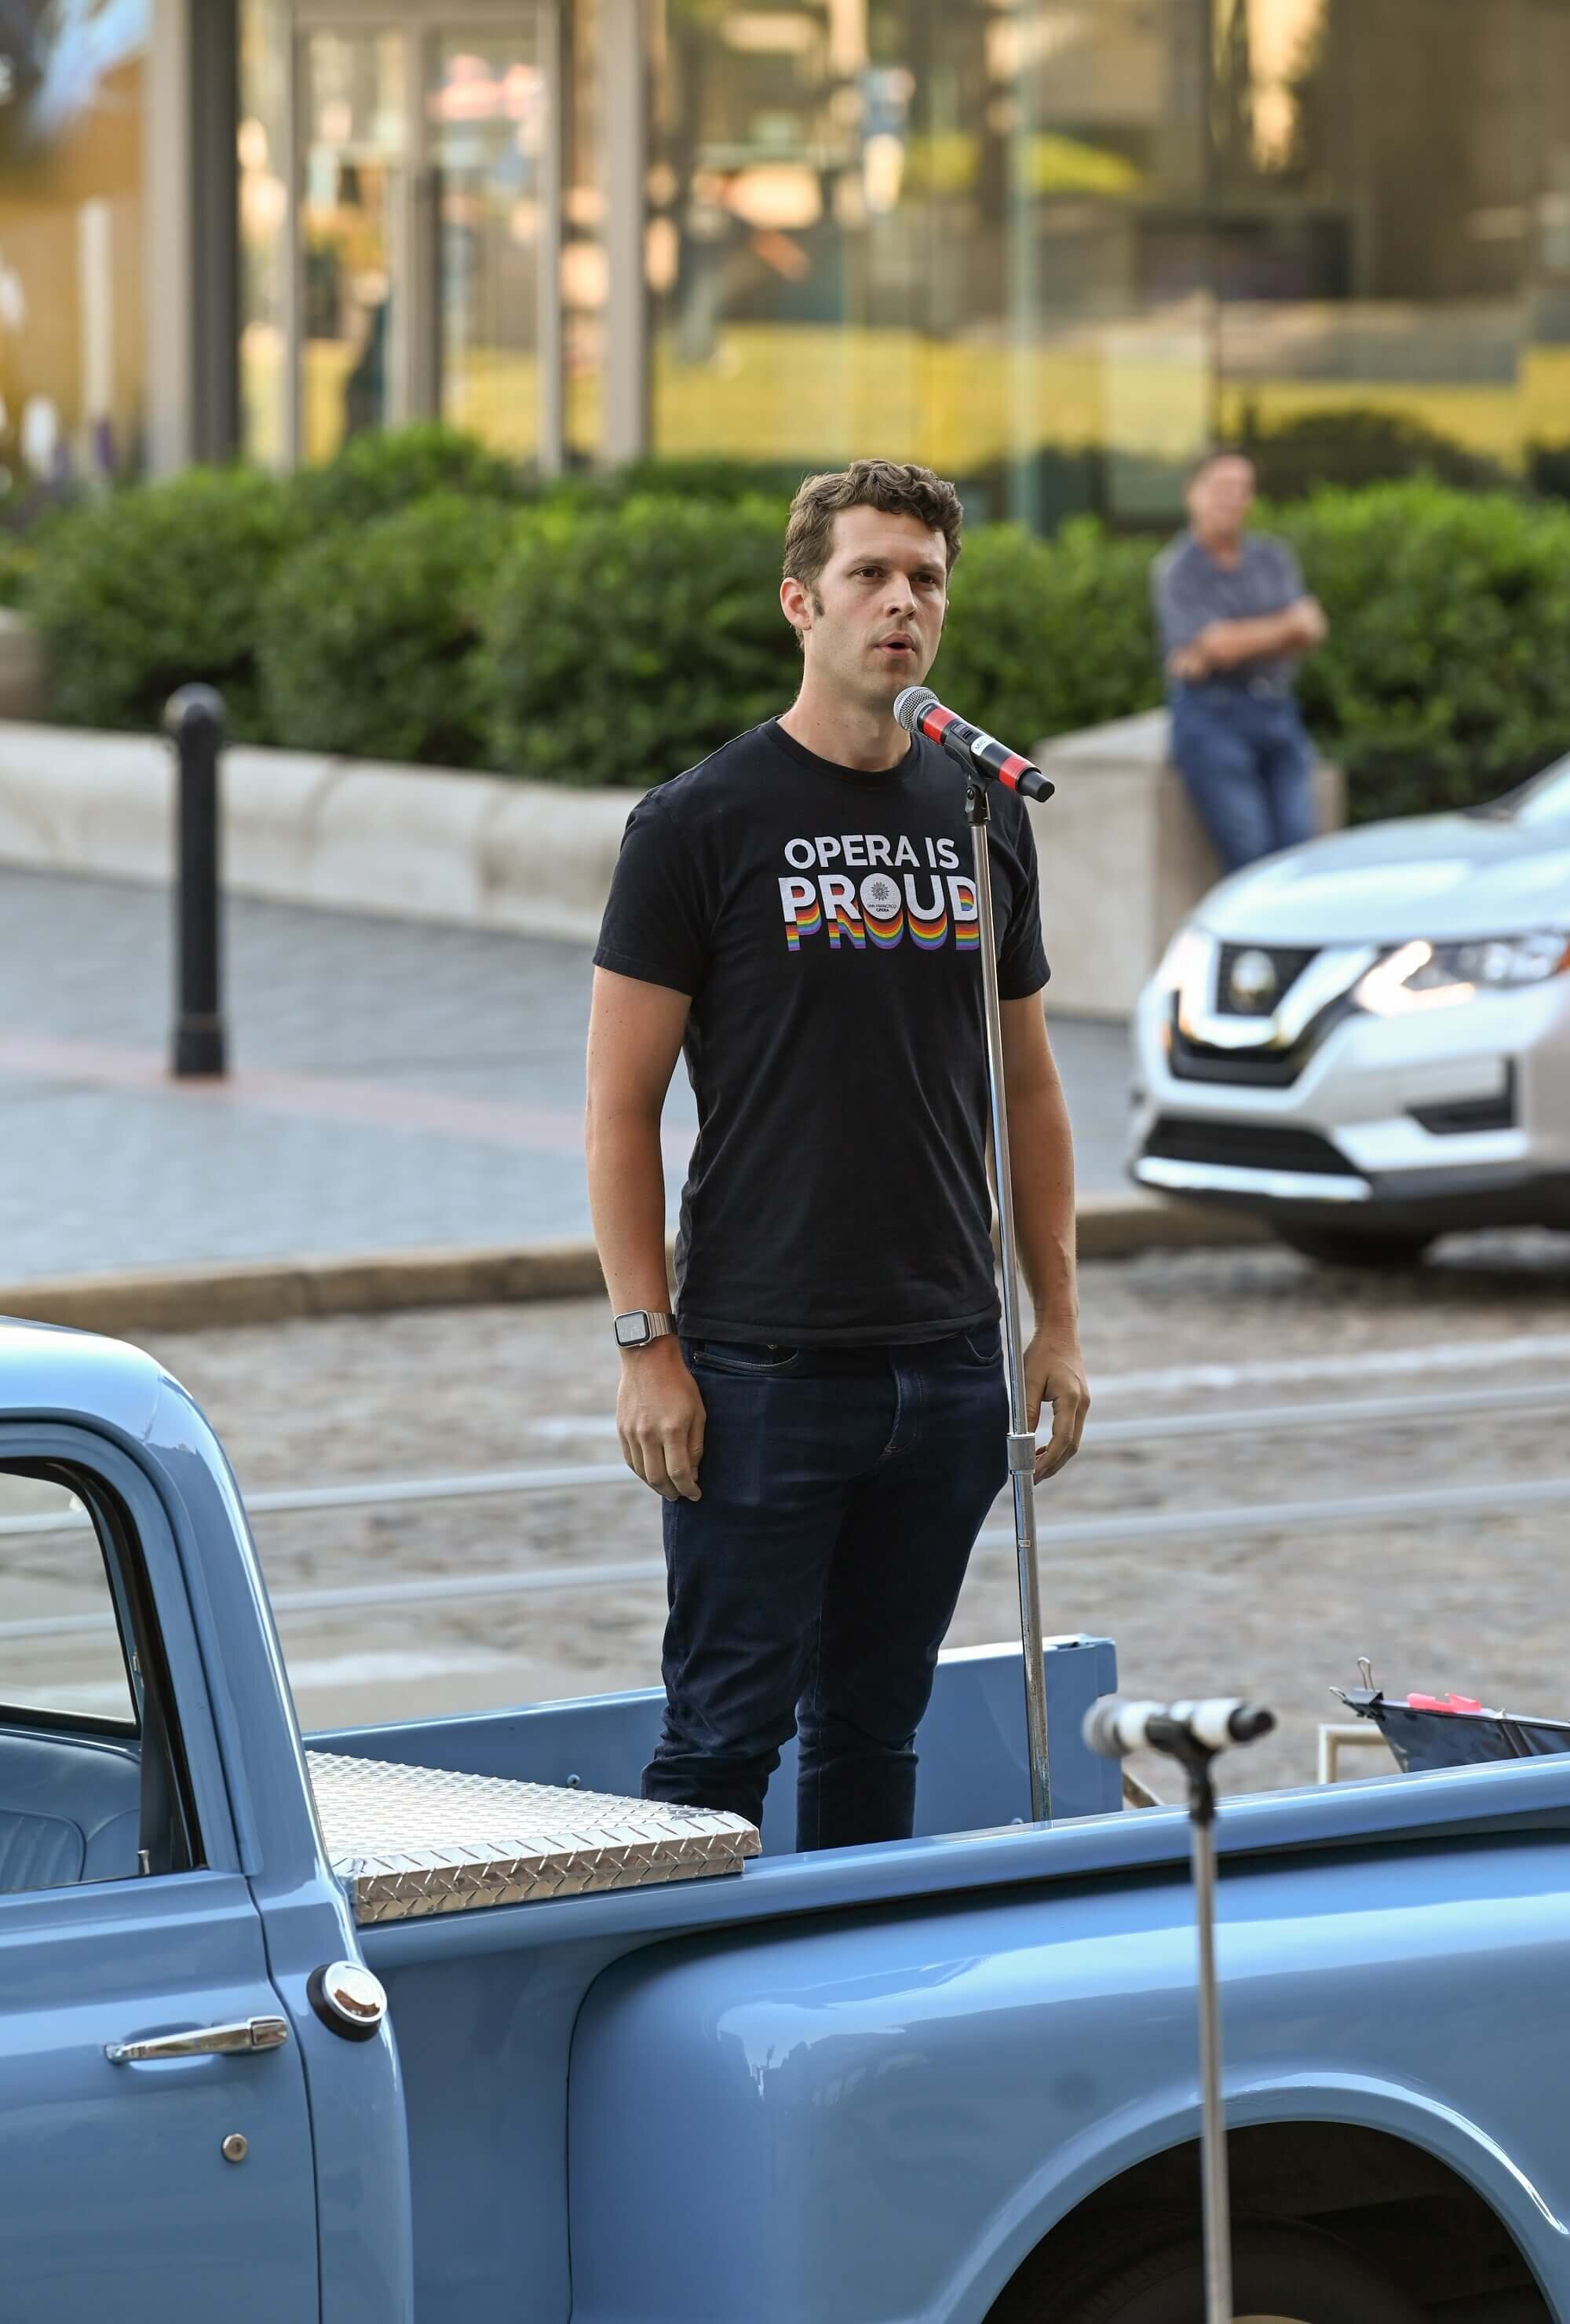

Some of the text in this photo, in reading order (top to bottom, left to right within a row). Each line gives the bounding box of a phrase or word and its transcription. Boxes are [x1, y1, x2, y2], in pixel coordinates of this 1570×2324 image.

[784, 835, 959, 869] OPERA IS
[778, 872, 979, 923] PROUD
